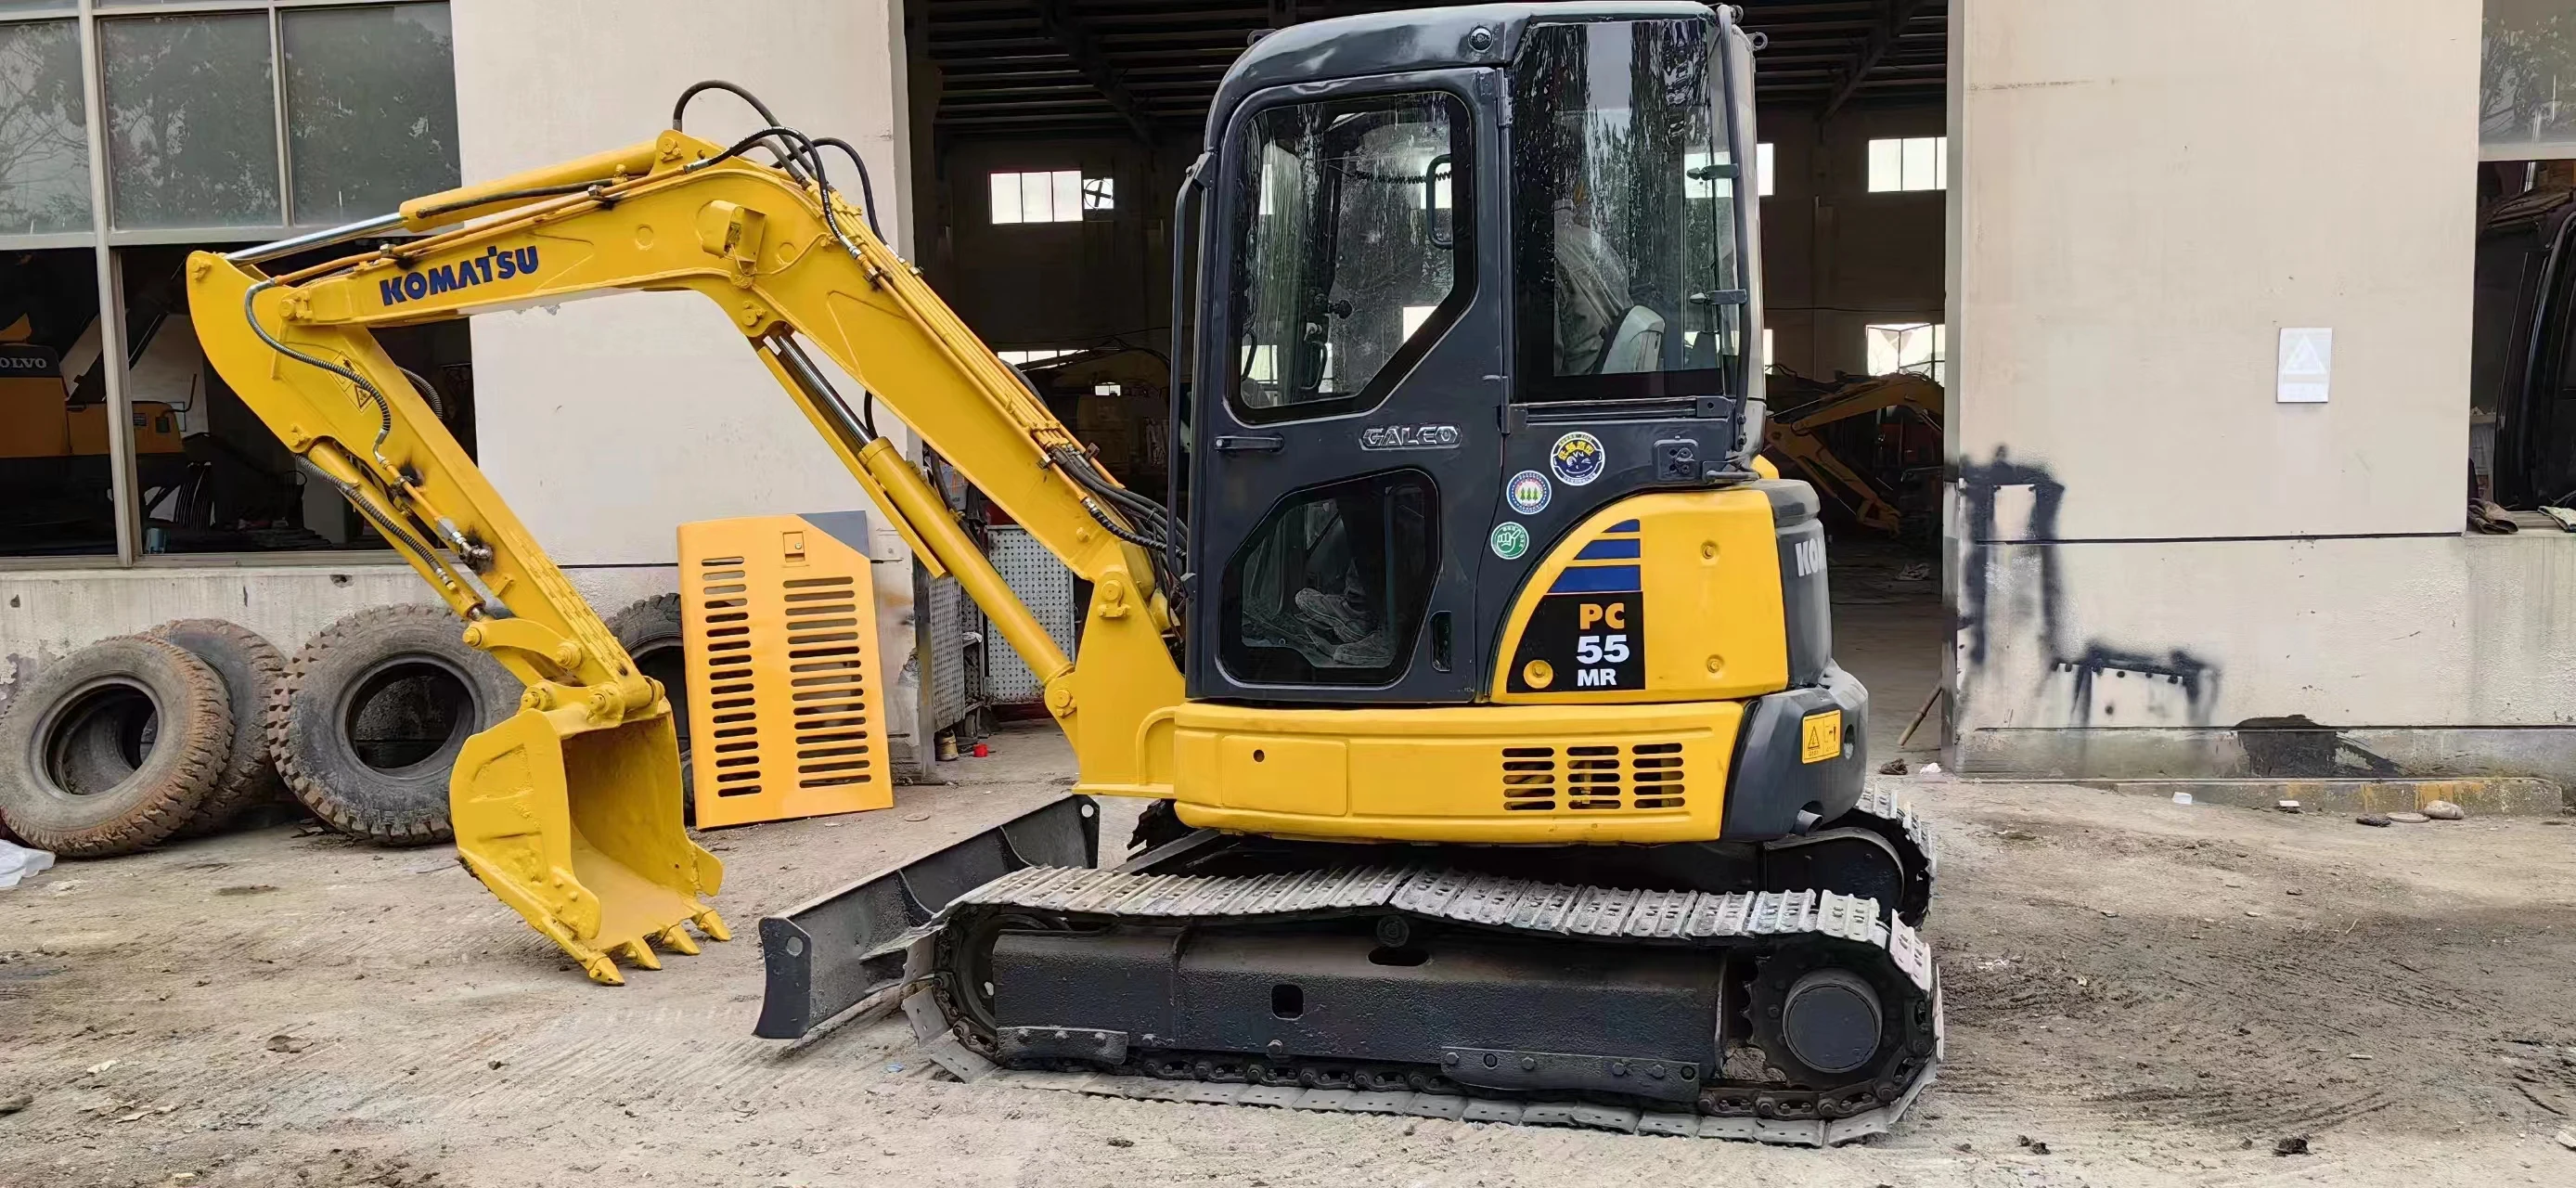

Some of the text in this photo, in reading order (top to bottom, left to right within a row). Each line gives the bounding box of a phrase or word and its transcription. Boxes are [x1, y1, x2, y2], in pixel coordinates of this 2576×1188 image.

[380, 245, 539, 306] KOMATSU
[1362, 426, 1459, 446] GALEO
[1579, 602, 1625, 630] PC
[1576, 634, 1630, 665] 55
[1577, 668, 1617, 687] MR
